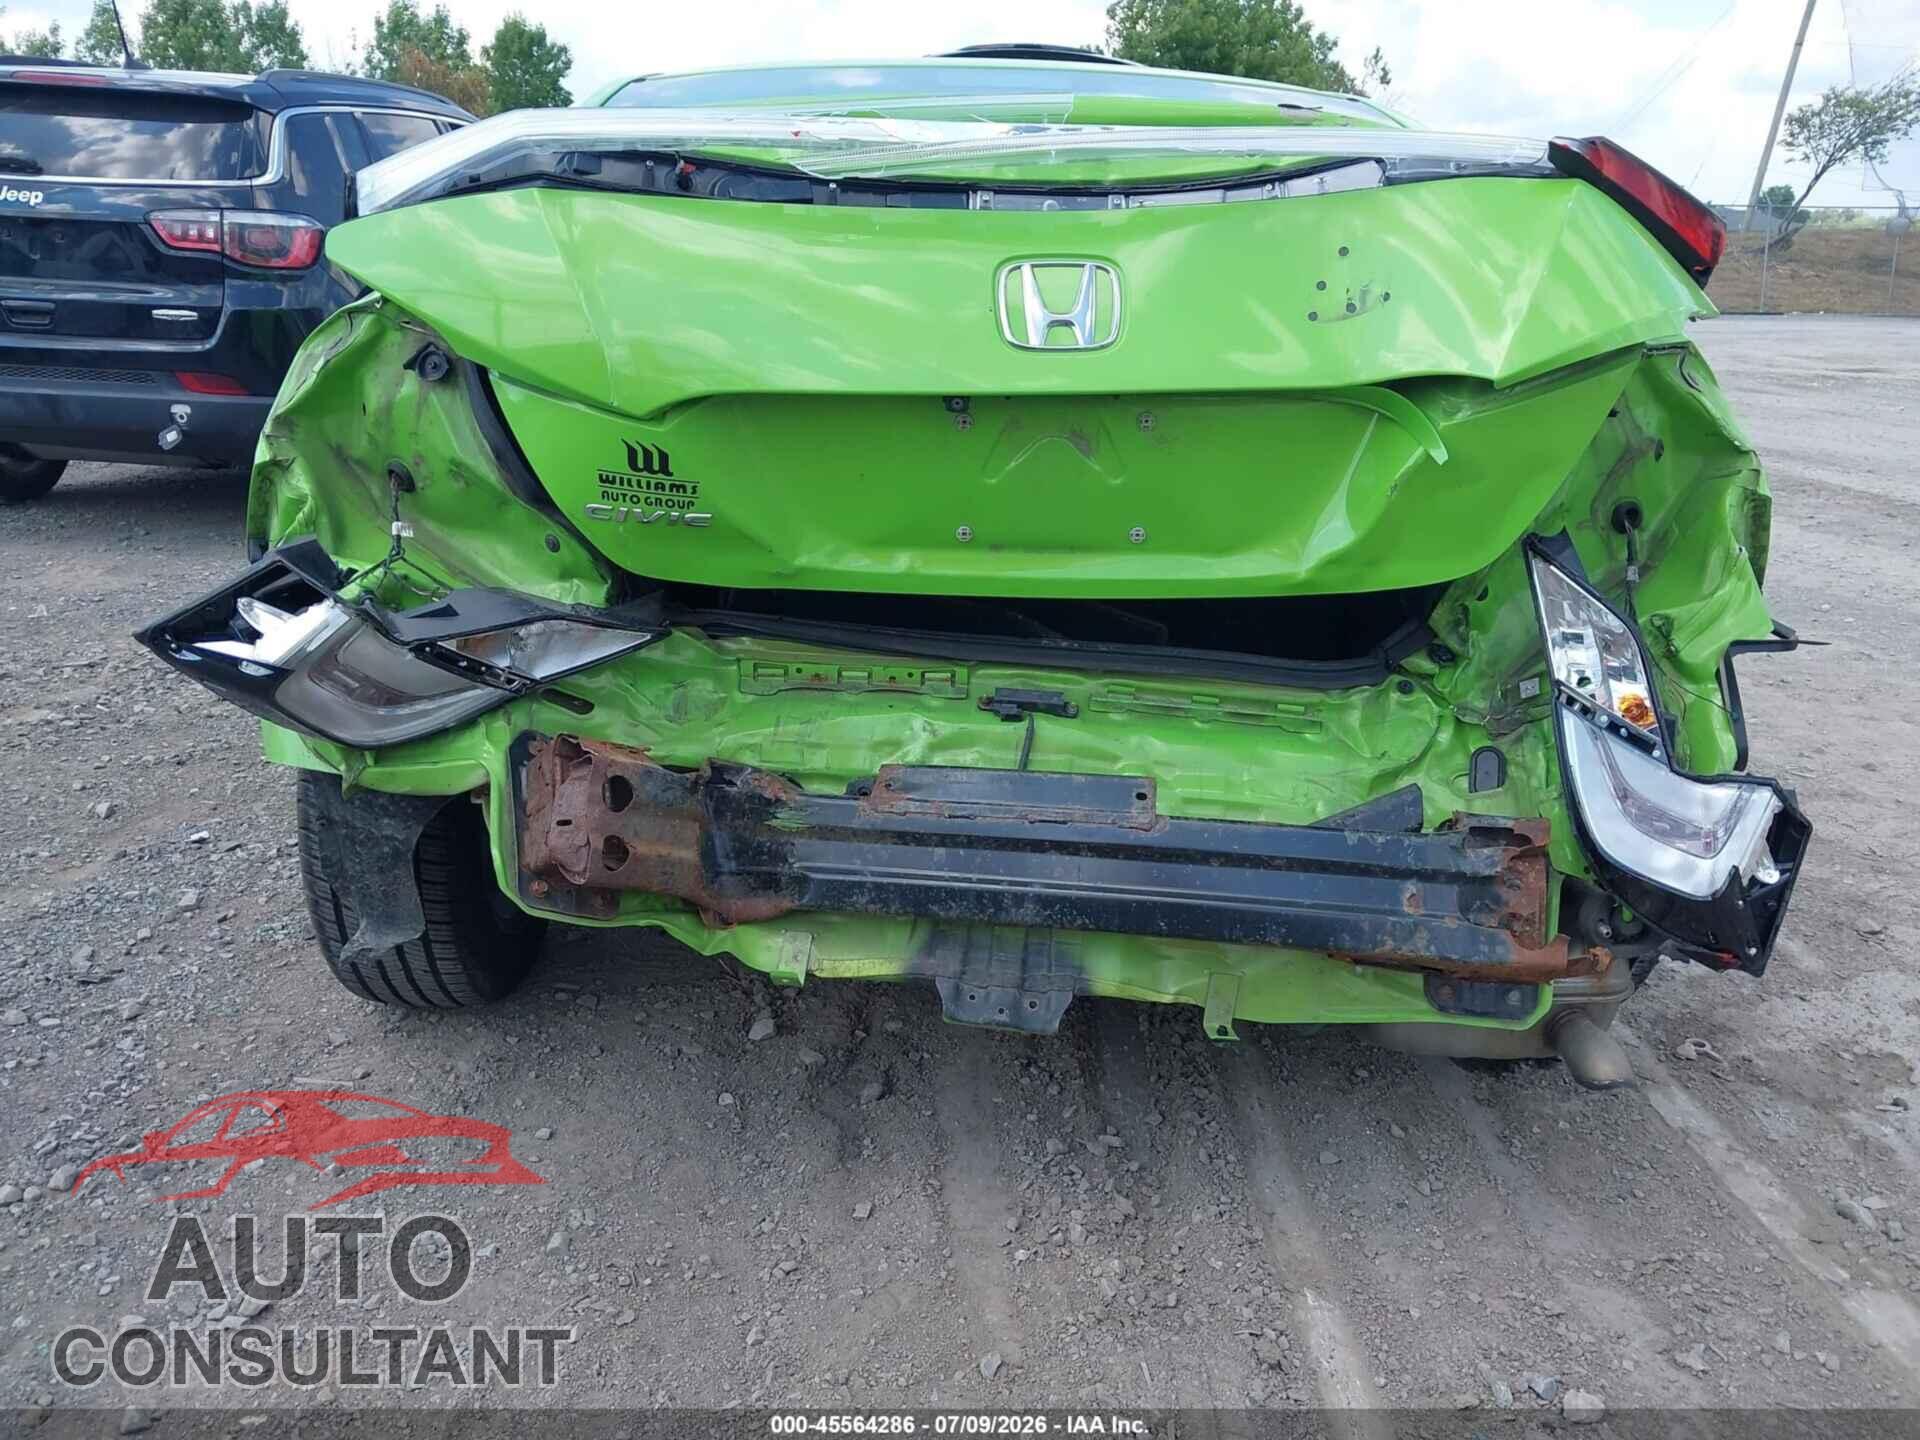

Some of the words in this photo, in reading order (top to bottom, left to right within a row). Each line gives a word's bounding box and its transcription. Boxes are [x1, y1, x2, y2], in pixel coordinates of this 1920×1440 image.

[0, 185, 44, 206] Jeep
[598, 472, 699, 495] WILLIAMS
[601, 490, 641, 505] AUTO
[644, 496, 695, 510] GROUP
[585, 503, 713, 527] CIVIC
